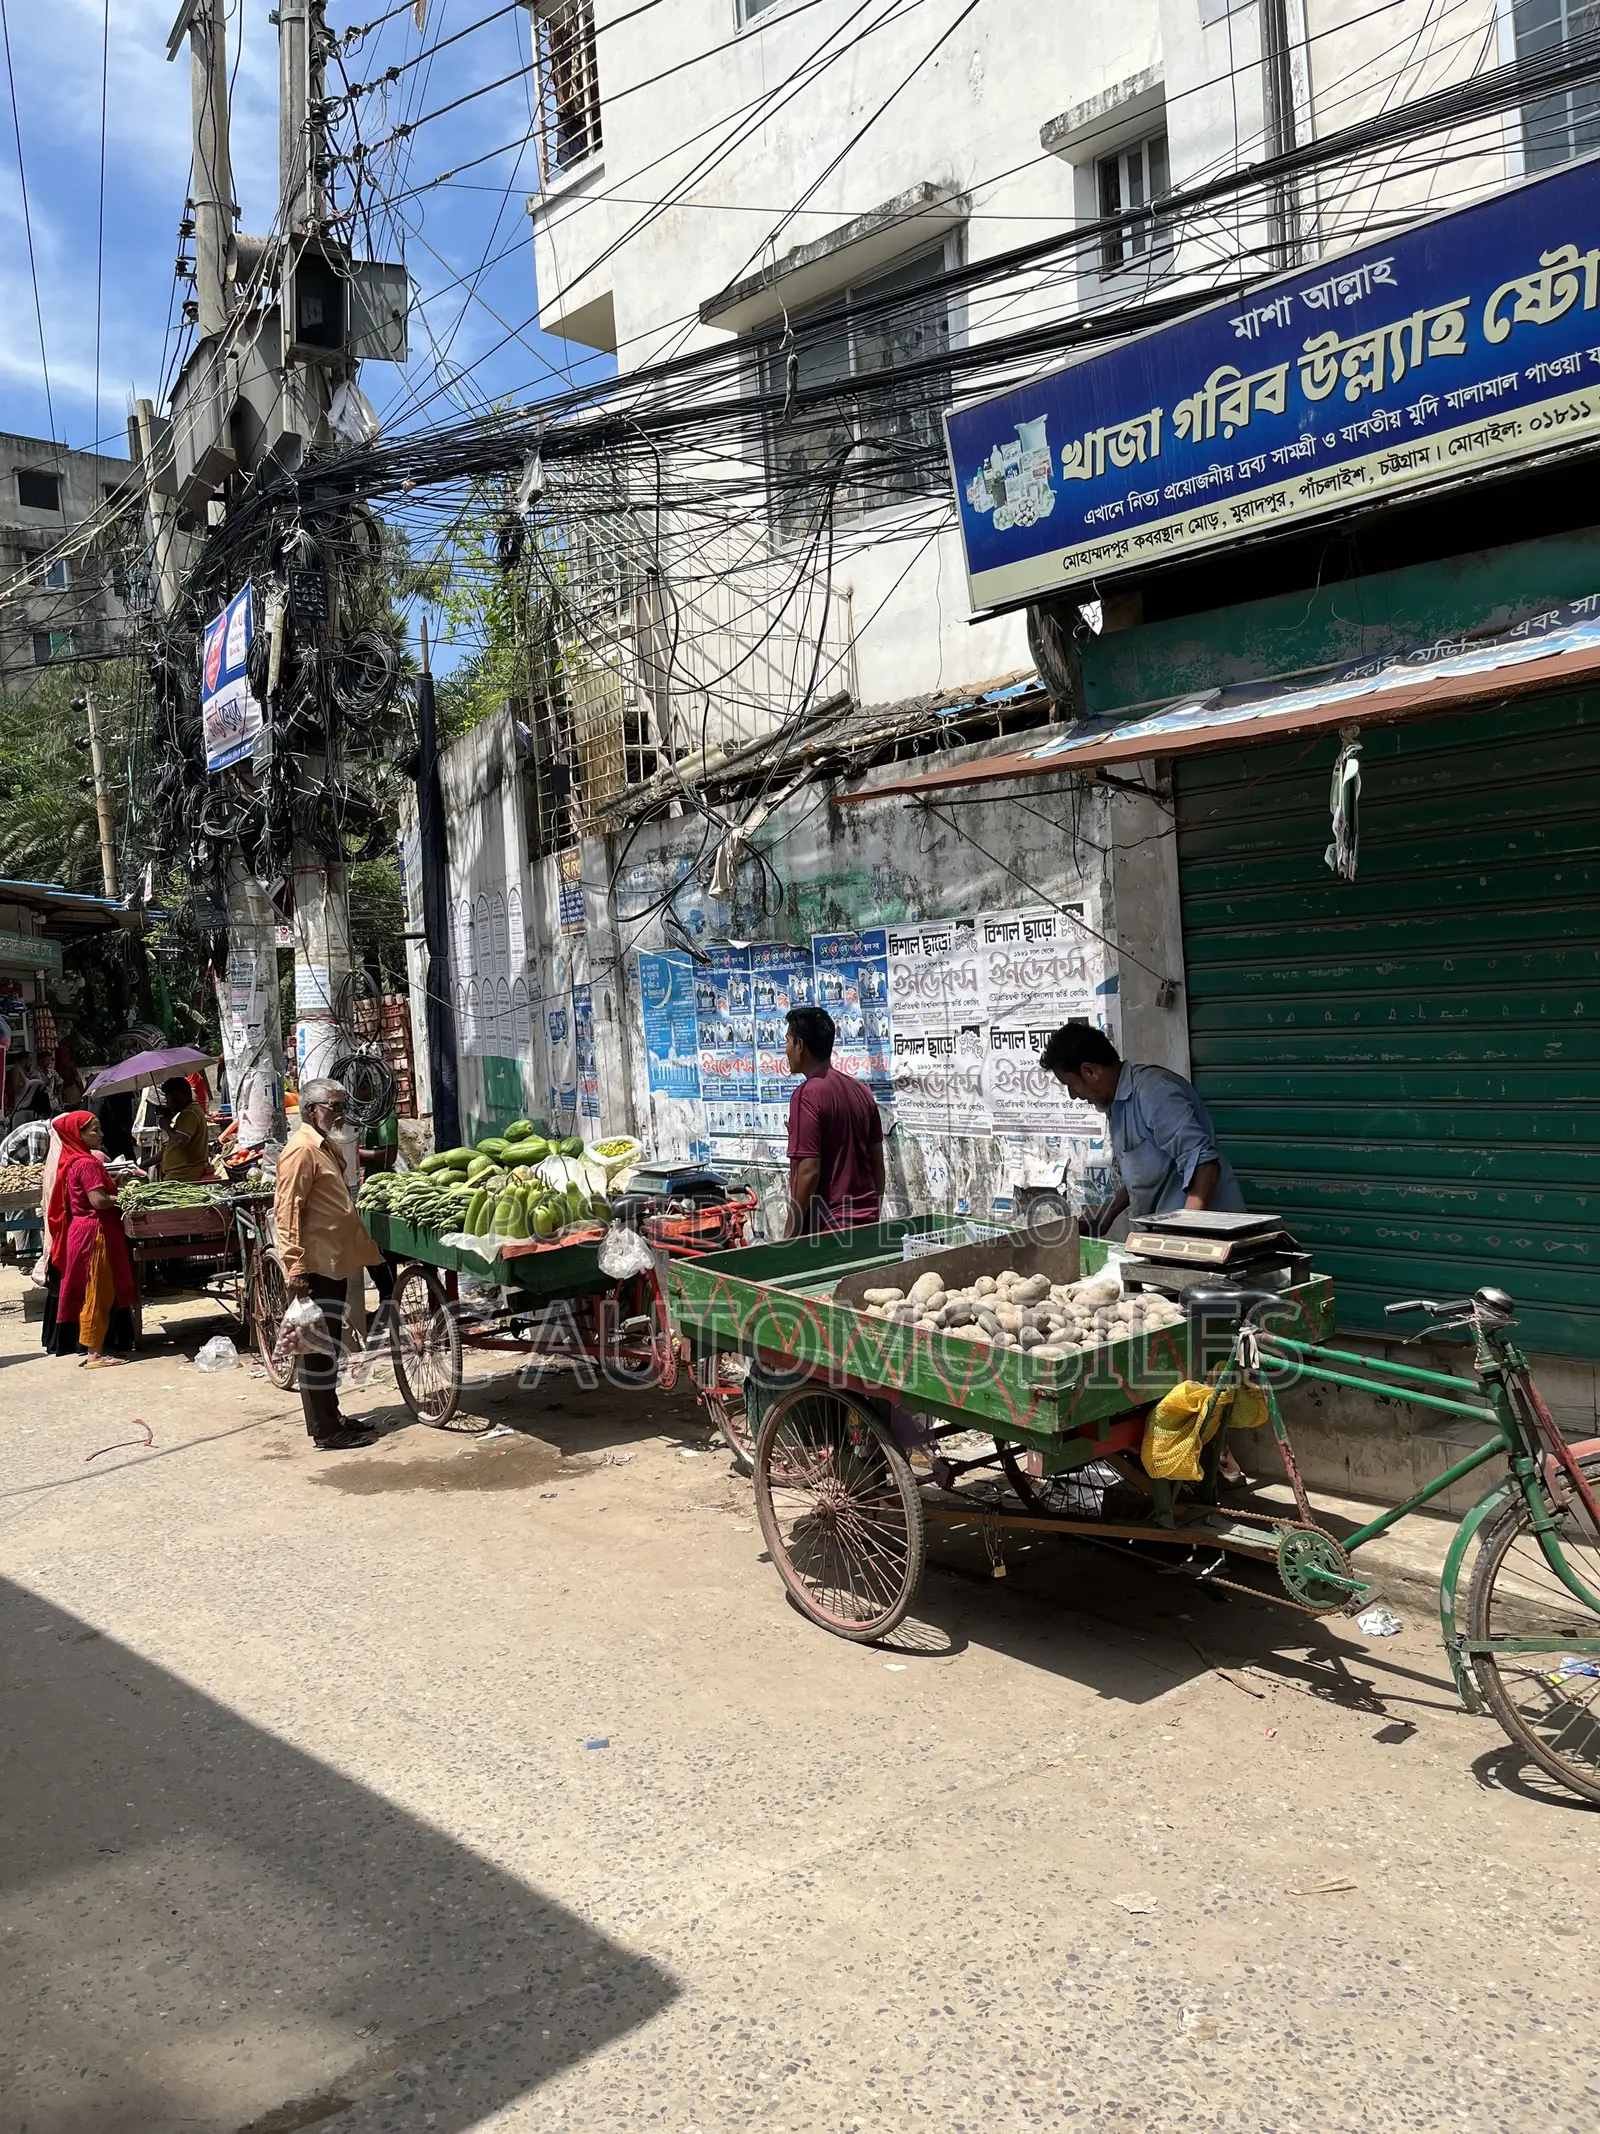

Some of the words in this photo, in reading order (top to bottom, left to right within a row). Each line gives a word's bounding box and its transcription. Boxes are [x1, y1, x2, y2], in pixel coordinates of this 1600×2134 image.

[1229, 295, 1293, 341] মাশা
[1300, 255, 1399, 312] আল্লাহ
[1061, 407, 1163, 481] খাজা
[1172, 365, 1290, 441] গরিব
[1084, 499, 1124, 525] এখানে
[1127, 488, 1160, 513] নিত্য
[1238, 454, 1266, 479] দ্রব্য
[1271, 433, 1316, 466] সামগ্রী
[1321, 434, 1337, 449] ও
[1339, 408, 1401, 443] যাবতীয়
[1406, 394, 1439, 426] মুদি
[1443, 371, 1518, 410] মালামাল
[1524, 351, 1582, 383] পাওয়া
[1063, 538, 1129, 571] মোহাম্মদপুর
[1529, 399, 1592, 432] ০১৮১১
[1510, 609, 1563, 637] এবং
[888, 934, 920, 956] বিশাল
[984, 920, 1020, 944] বিশাল
[894, 1033, 925, 1056] বিশাল
[990, 1026, 1026, 1050] বিশাল
